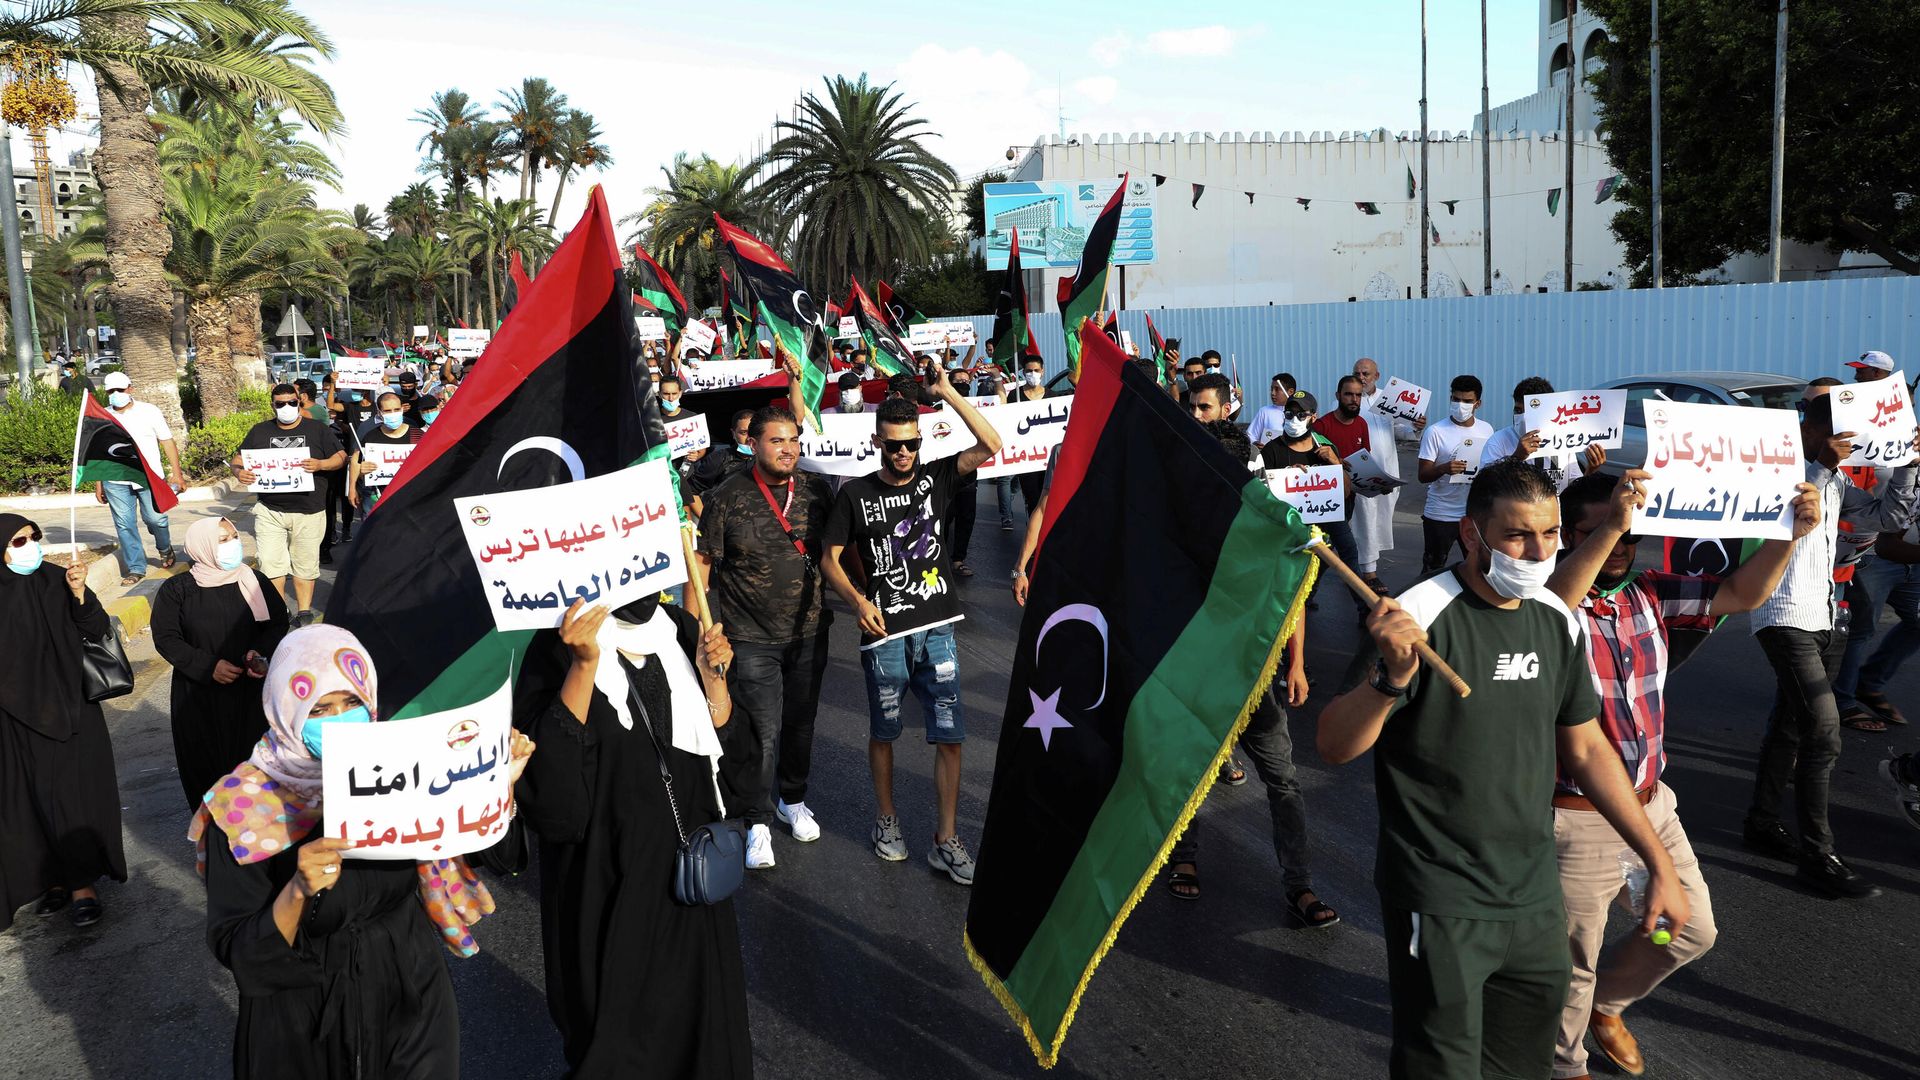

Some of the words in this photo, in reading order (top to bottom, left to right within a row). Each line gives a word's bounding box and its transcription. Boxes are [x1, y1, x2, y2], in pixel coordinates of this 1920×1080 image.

[1395, 388, 1421, 405] نعم
[1550, 395, 1602, 425] تغيير
[665, 421, 698, 440] البركا
[1539, 434, 1562, 449] راح
[1566, 427, 1617, 449] السروج
[816, 440, 852, 457] ساند
[1654, 431, 1733, 473] البركان
[1741, 434, 1796, 475] شباب
[1850, 440, 1879, 460] راح
[282, 458, 303, 470] قوق
[1285, 473, 1338, 497] مطلبنا
[1307, 499, 1340, 516] حكومة
[1646, 486, 1739, 522] الفساد
[1742, 493, 1784, 522] ضد
[611, 501, 666, 538] ماتوا
[479, 528, 541, 563] تريس
[544, 522, 605, 553] عليها
[619, 551, 671, 586] هذه
[492, 570, 611, 611] العاصمة
[348, 761, 420, 797] امنا
[340, 816, 444, 852] بدمنا
